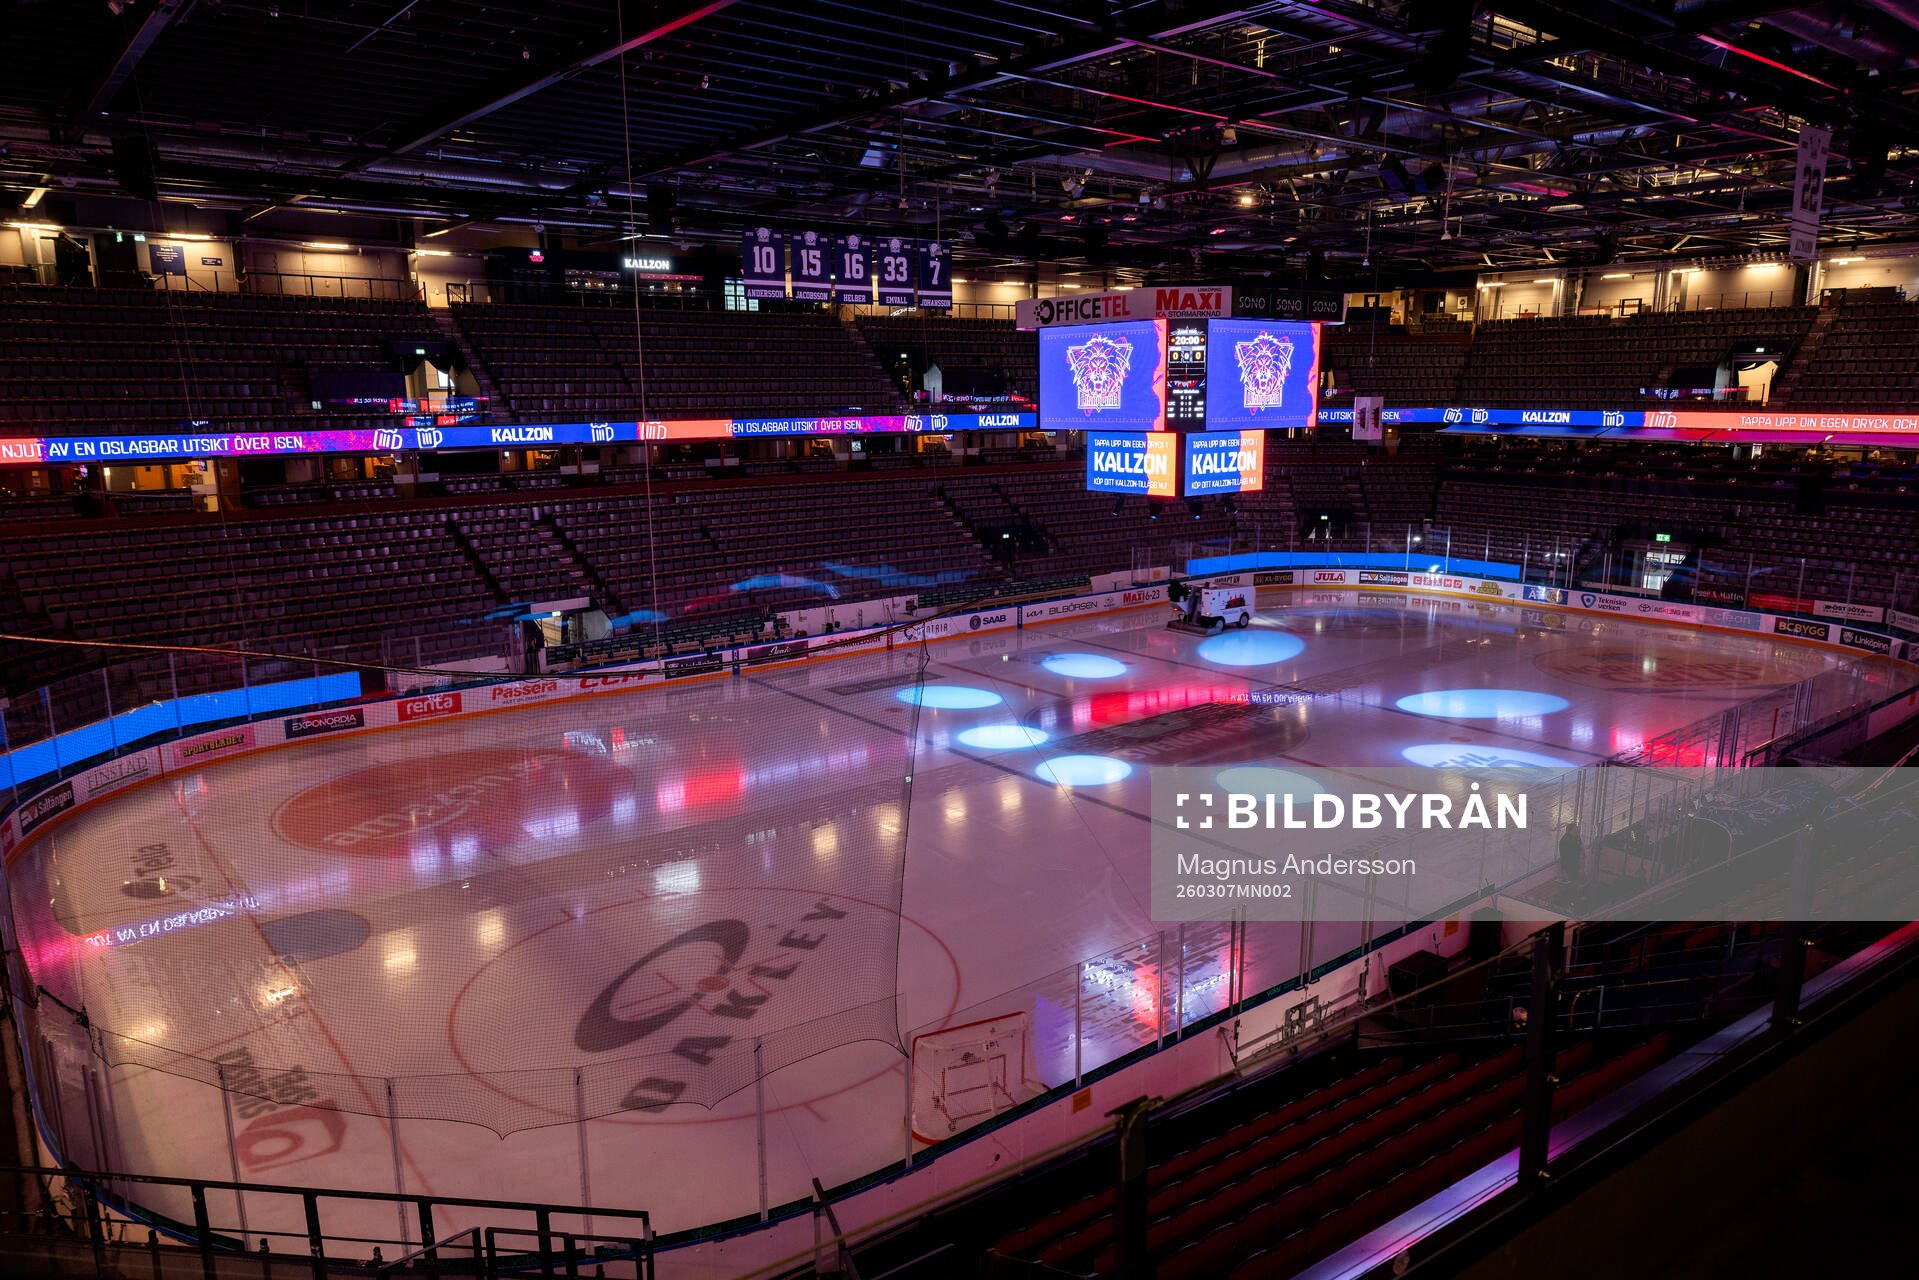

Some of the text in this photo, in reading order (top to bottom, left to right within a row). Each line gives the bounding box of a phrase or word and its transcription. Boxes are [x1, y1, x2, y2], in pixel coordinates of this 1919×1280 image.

[625, 258, 670, 270] KALLZON
[753, 246, 776, 273] 10
[801, 249, 821, 276] 15
[844, 253, 864, 279] 16
[884, 256, 908, 282] 33
[929, 260, 941, 285] 7
[747, 289, 784, 298] ANDERSSON
[795, 291, 828, 301] JACOBSSON
[844, 294, 866, 303] HELBER
[1155, 289, 1223, 310] MAXI
[886, 296, 908, 305] EMVALL
[920, 299, 951, 308] JOHANSSON
[1239, 296, 1266, 309] SONO
[1276, 298, 1303, 311] SONO
[1312, 300, 1338, 313] SONO
[1034, 294, 1131, 325] OFFICETEL
[1175, 336, 1200, 345] 20:00
[978, 415, 1020, 427] KALLZON
[1522, 412, 1570, 423] KALLZON
[1740, 416, 1918, 430] TAPPA UPP DIN EGEN DRYCK OCH
[746, 421, 790, 433] OSLAGBAR
[791, 420, 819, 432] UTSIKT
[491, 426, 553, 442] KALLZON
[3, 435, 306, 460] NJUT AV EN OSLAGBAR UTSIKT ÖVER ISEN.
[1094, 439, 1110, 448] TAPPA
[1111, 439, 1122, 448] UPP
[1132, 440, 1146, 449] EGEN
[1193, 440, 1207, 448] TAPPA
[1208, 440, 1218, 448] UPP
[1094, 452, 1168, 475] KALLZON
[1192, 450, 1257, 475] KALLZON
[1315, 572, 1345, 582] JULA
[1123, 591, 1145, 605] MAXI
[1026, 609, 1043, 618] KIA
[1049, 600, 1098, 615] BILBÖRSEN
[1598, 604, 1621, 612] verken
[982, 614, 1007, 625] SAAB
[1779, 621, 1826, 637] BCBYGG
[492, 680, 558, 700] Passera
[406, 694, 454, 714] renta
[292, 713, 357, 732] EXPONORDIA
[183, 734, 245, 758] SPORTBLADET
